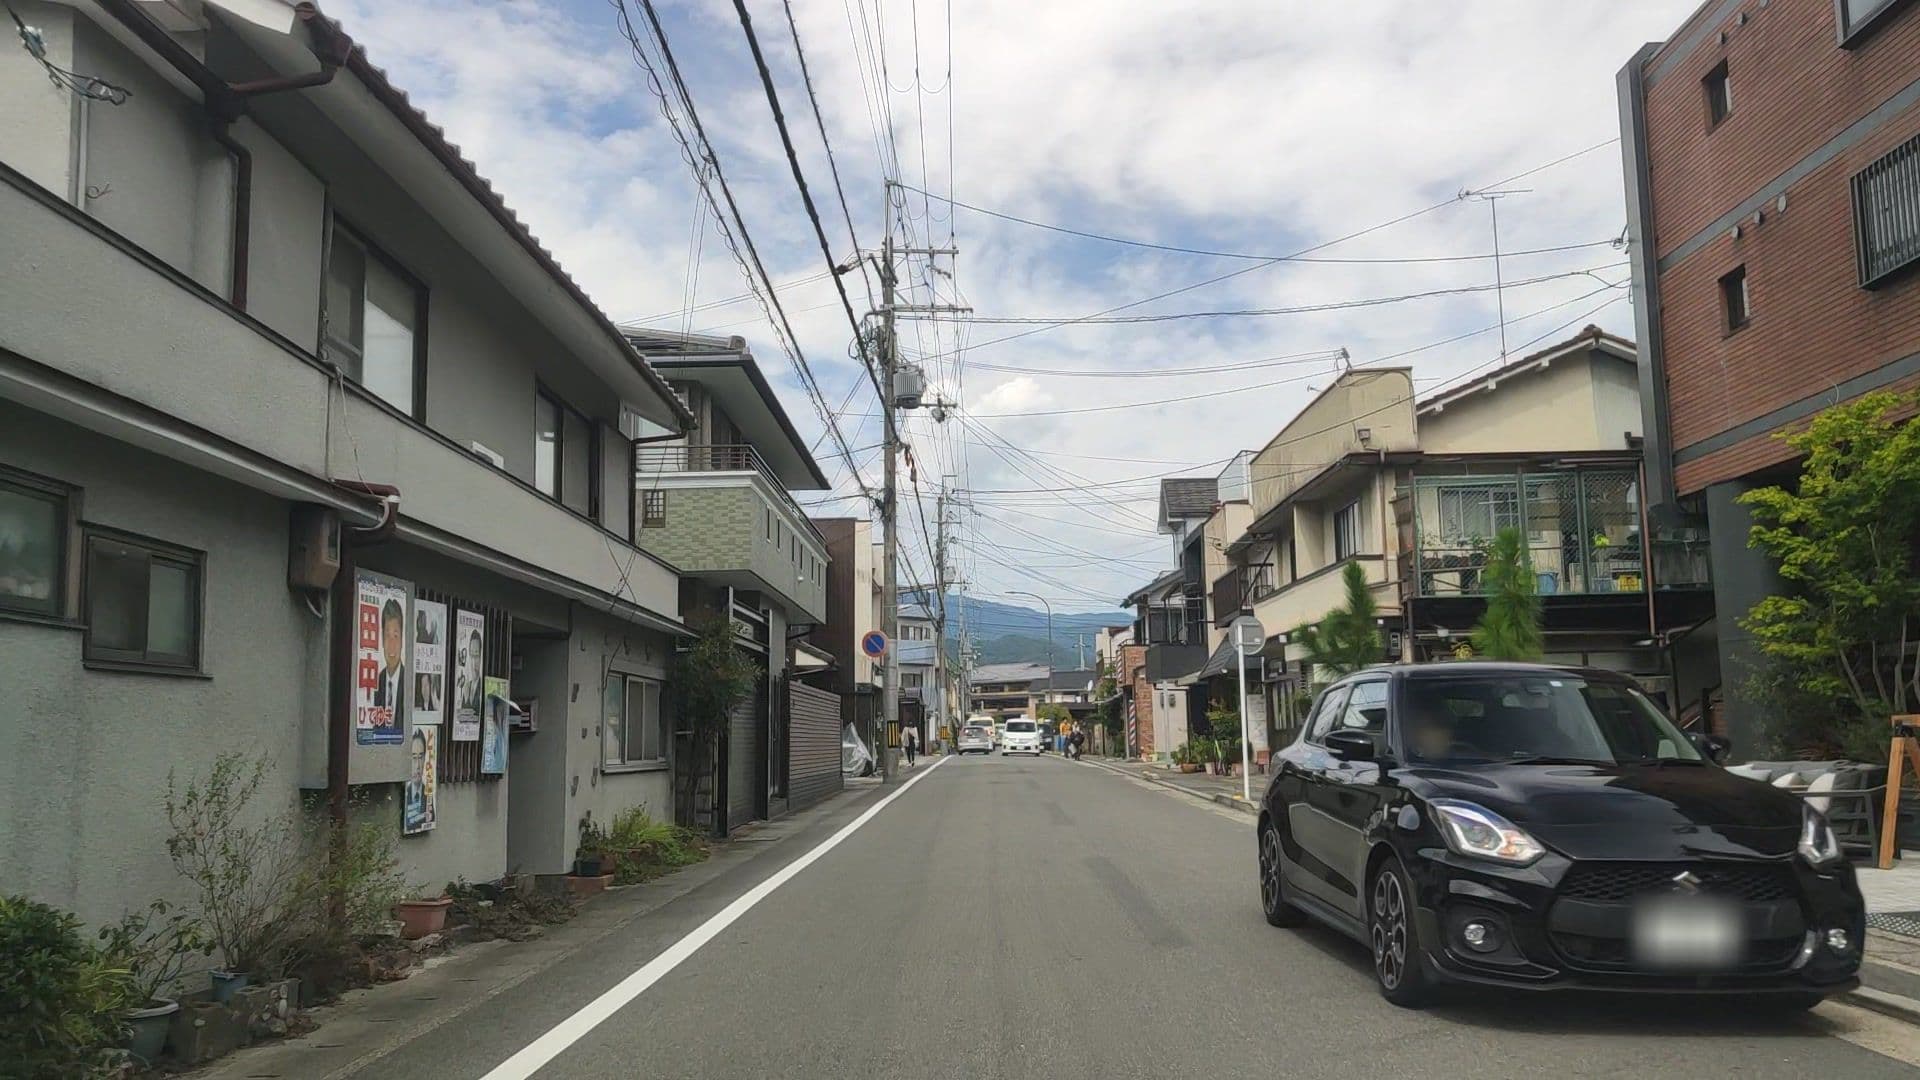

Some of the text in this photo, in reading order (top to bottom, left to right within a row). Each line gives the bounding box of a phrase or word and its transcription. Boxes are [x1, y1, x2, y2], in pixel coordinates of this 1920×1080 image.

[359, 604, 380, 701] 田中
[358, 705, 393, 727] ひでゆき
